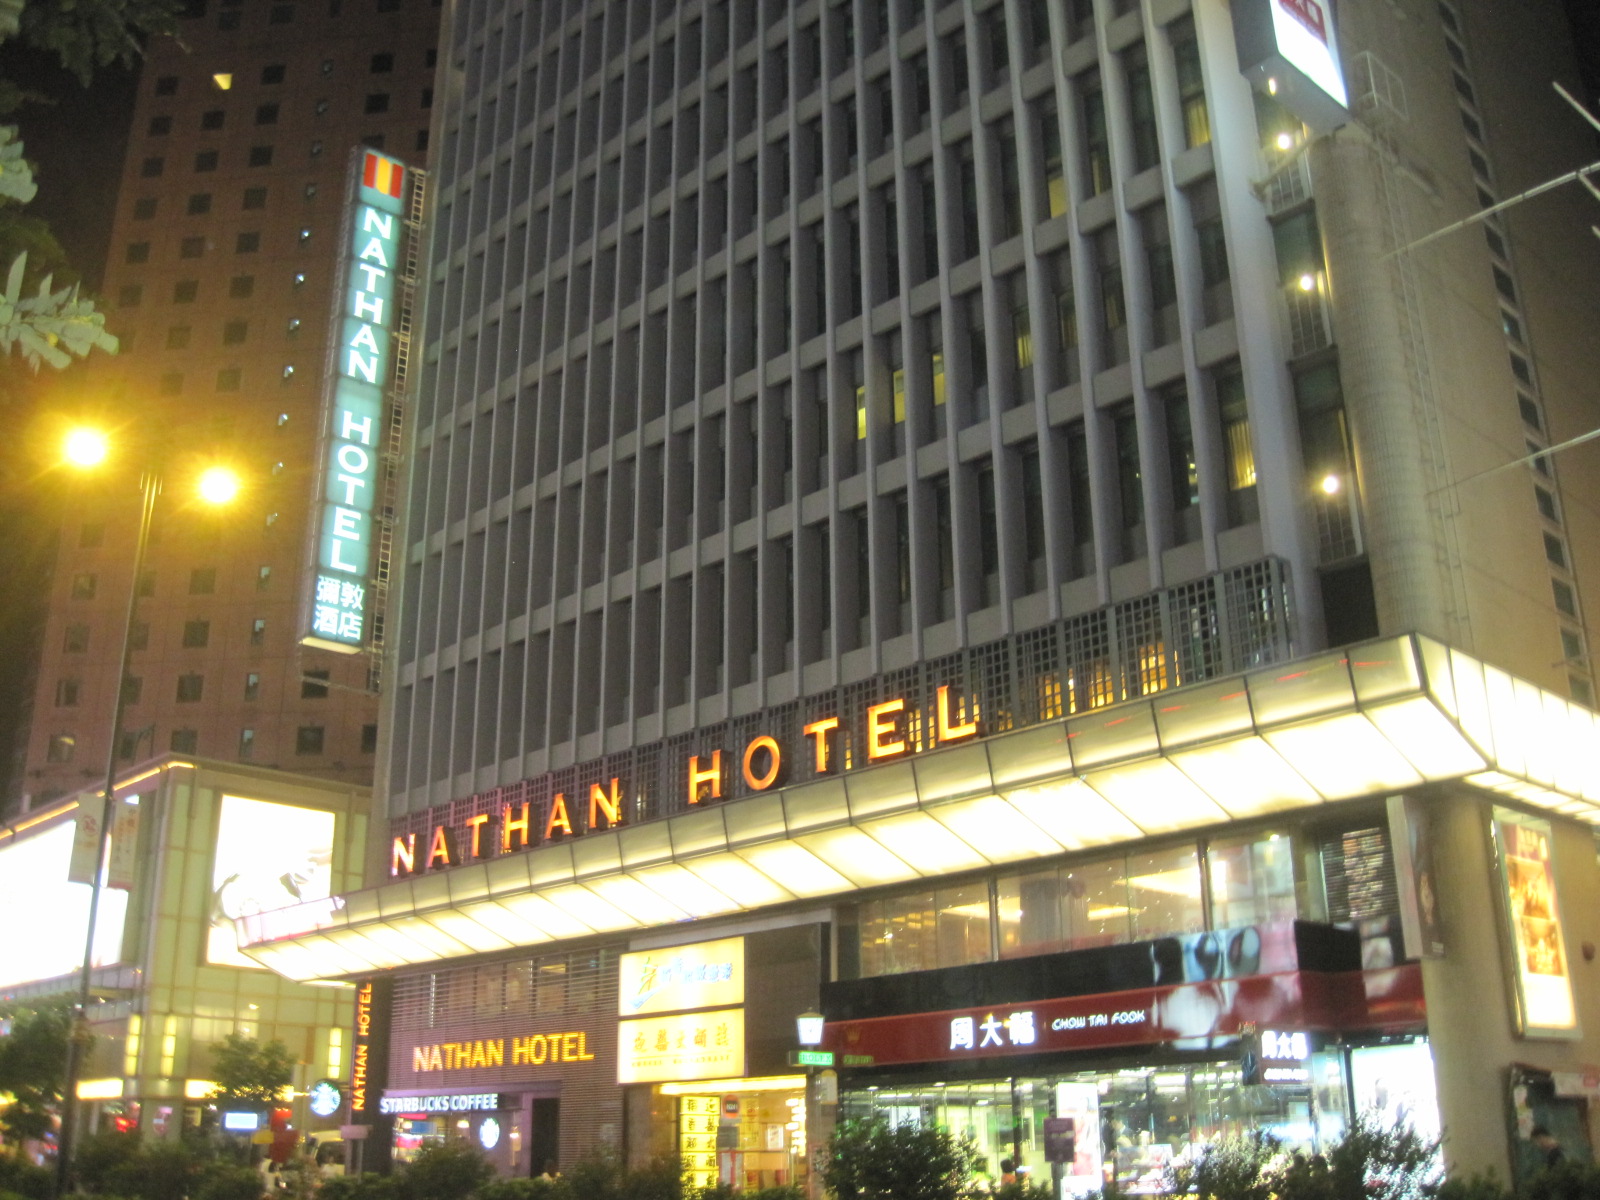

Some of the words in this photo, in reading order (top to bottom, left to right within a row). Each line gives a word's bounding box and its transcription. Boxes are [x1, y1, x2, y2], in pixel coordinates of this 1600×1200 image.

[348, 207, 393, 384] NATHAN
[330, 410, 372, 573] HOTEL
[313, 604, 363, 640] 酒店
[391, 777, 621, 876] NATHAN
[688, 685, 977, 804] HOTEL
[357, 983, 372, 1036] HOTEL
[1052, 1018, 1086, 1031] CHOW
[1089, 1014, 1108, 1027] TAI
[1112, 1010, 1145, 1024] FOOK
[351, 1044, 368, 1111] NATHAN
[412, 1038, 504, 1073] NATHAN
[511, 1031, 595, 1066] HOTEL
[380, 1096, 449, 1114] STARBUCKS
[450, 1093, 499, 1111] COFFEE
